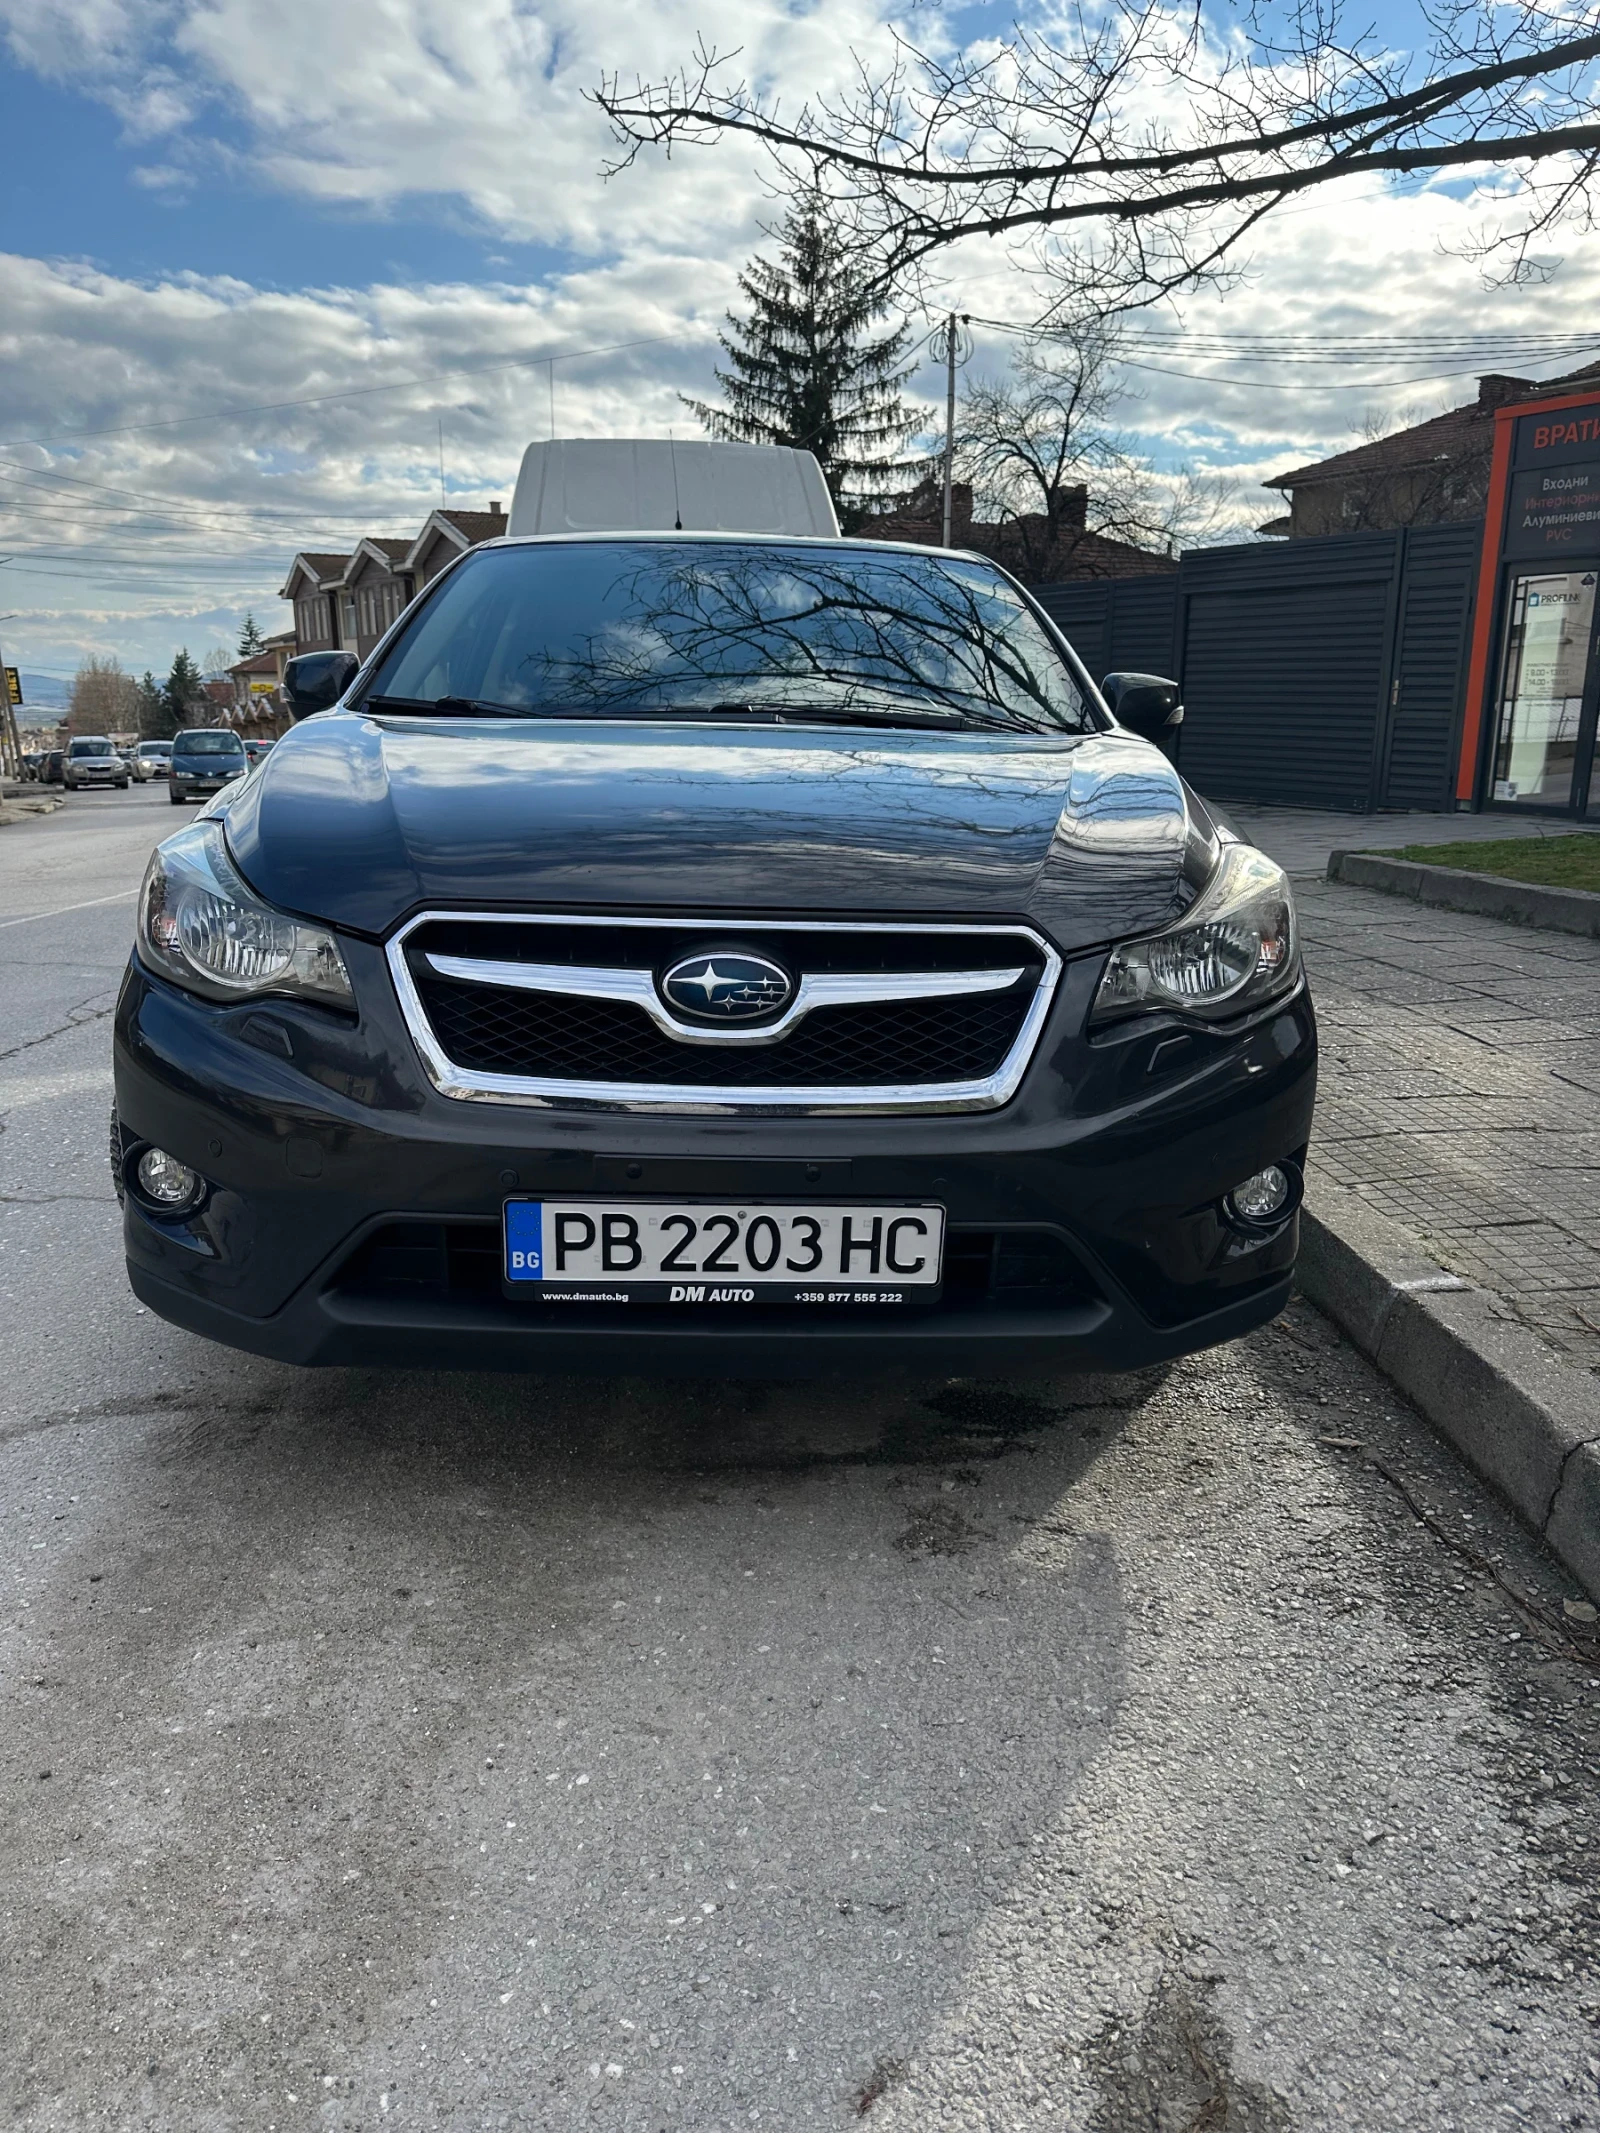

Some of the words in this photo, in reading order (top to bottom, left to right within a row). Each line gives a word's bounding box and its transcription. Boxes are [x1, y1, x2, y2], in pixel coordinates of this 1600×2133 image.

[1542, 476, 1589, 491] Входни
[1546, 528, 1573, 541] PVC
[555, 1212, 642, 1271] PB
[660, 1214, 823, 1272] 2203
[840, 1216, 927, 1274] HC
[512, 1251, 540, 1268] BG
[542, 1292, 629, 1302] www.dmauto.bg
[669, 1286, 705, 1302] DM
[708, 1288, 755, 1302] AUTO
[794, 1293, 824, 1302] +359
[828, 1293, 850, 1302] 877
[853, 1293, 876, 1302] 555
[879, 1293, 903, 1302] 222
